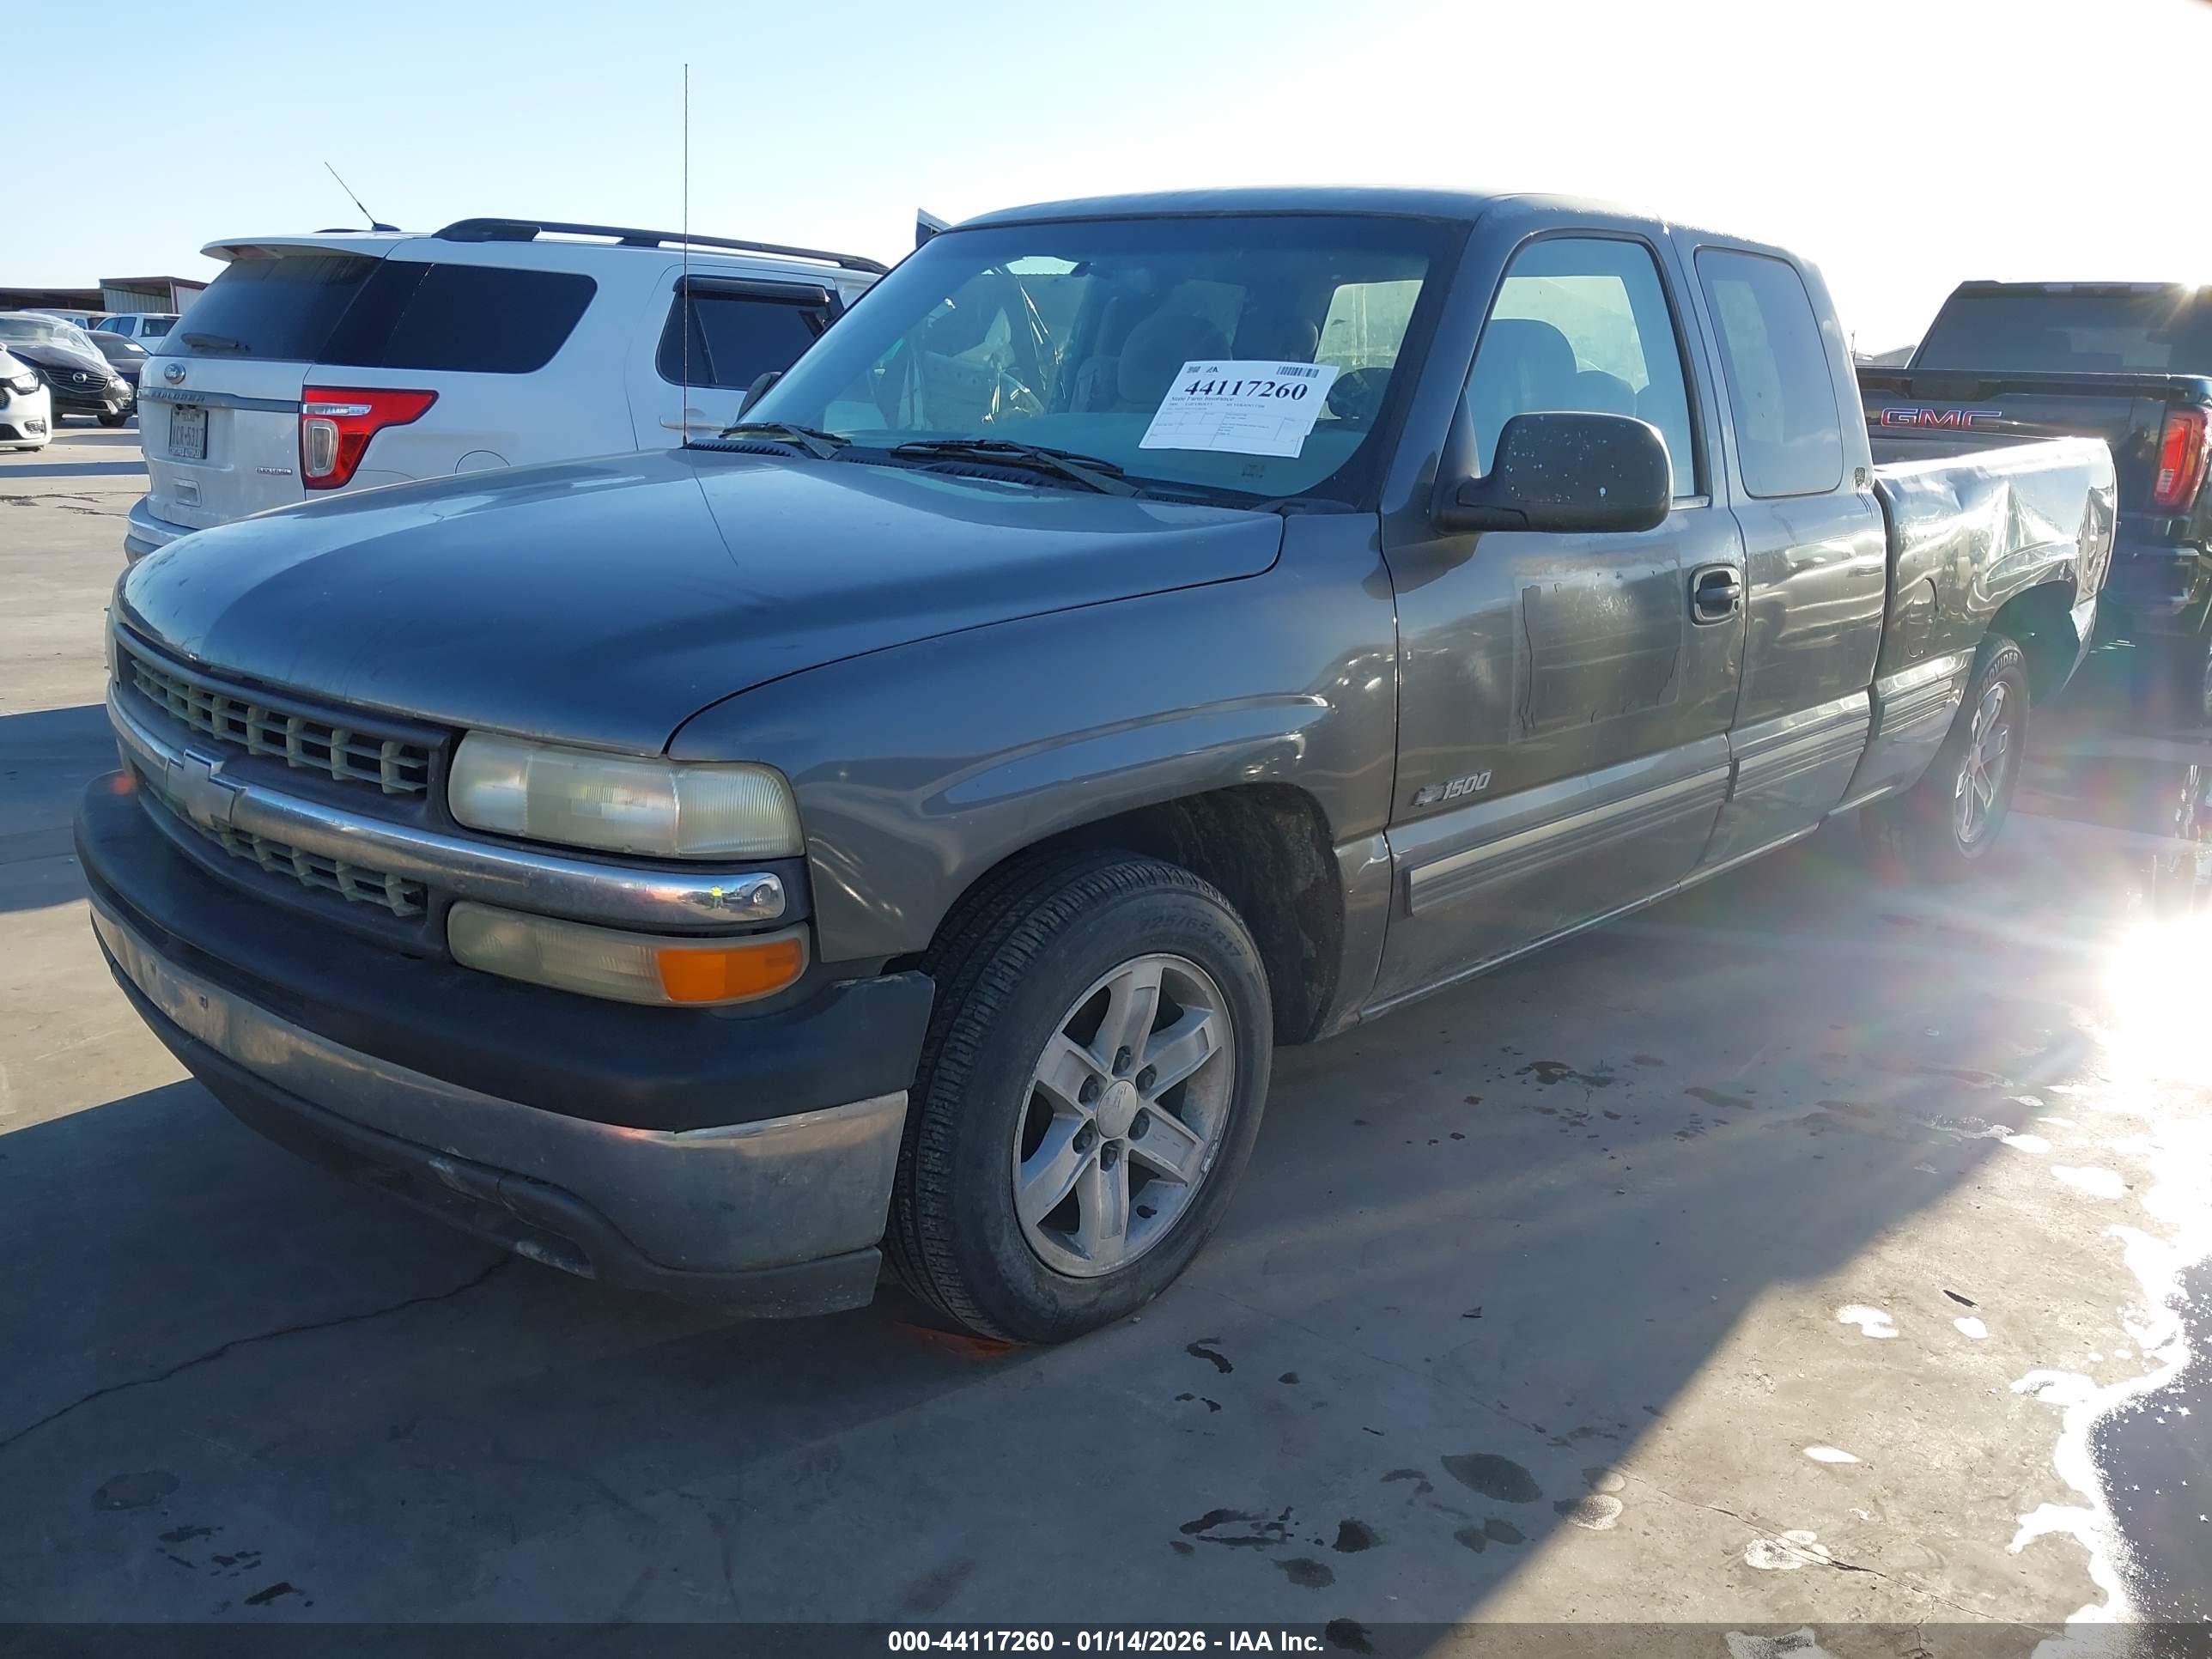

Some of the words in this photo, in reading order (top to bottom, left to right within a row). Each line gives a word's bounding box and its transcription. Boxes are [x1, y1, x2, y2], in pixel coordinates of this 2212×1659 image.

[1184, 380, 1309, 401] 44117260
[1881, 408, 2002, 428] GMC
[1443, 770, 1492, 799] 1500
